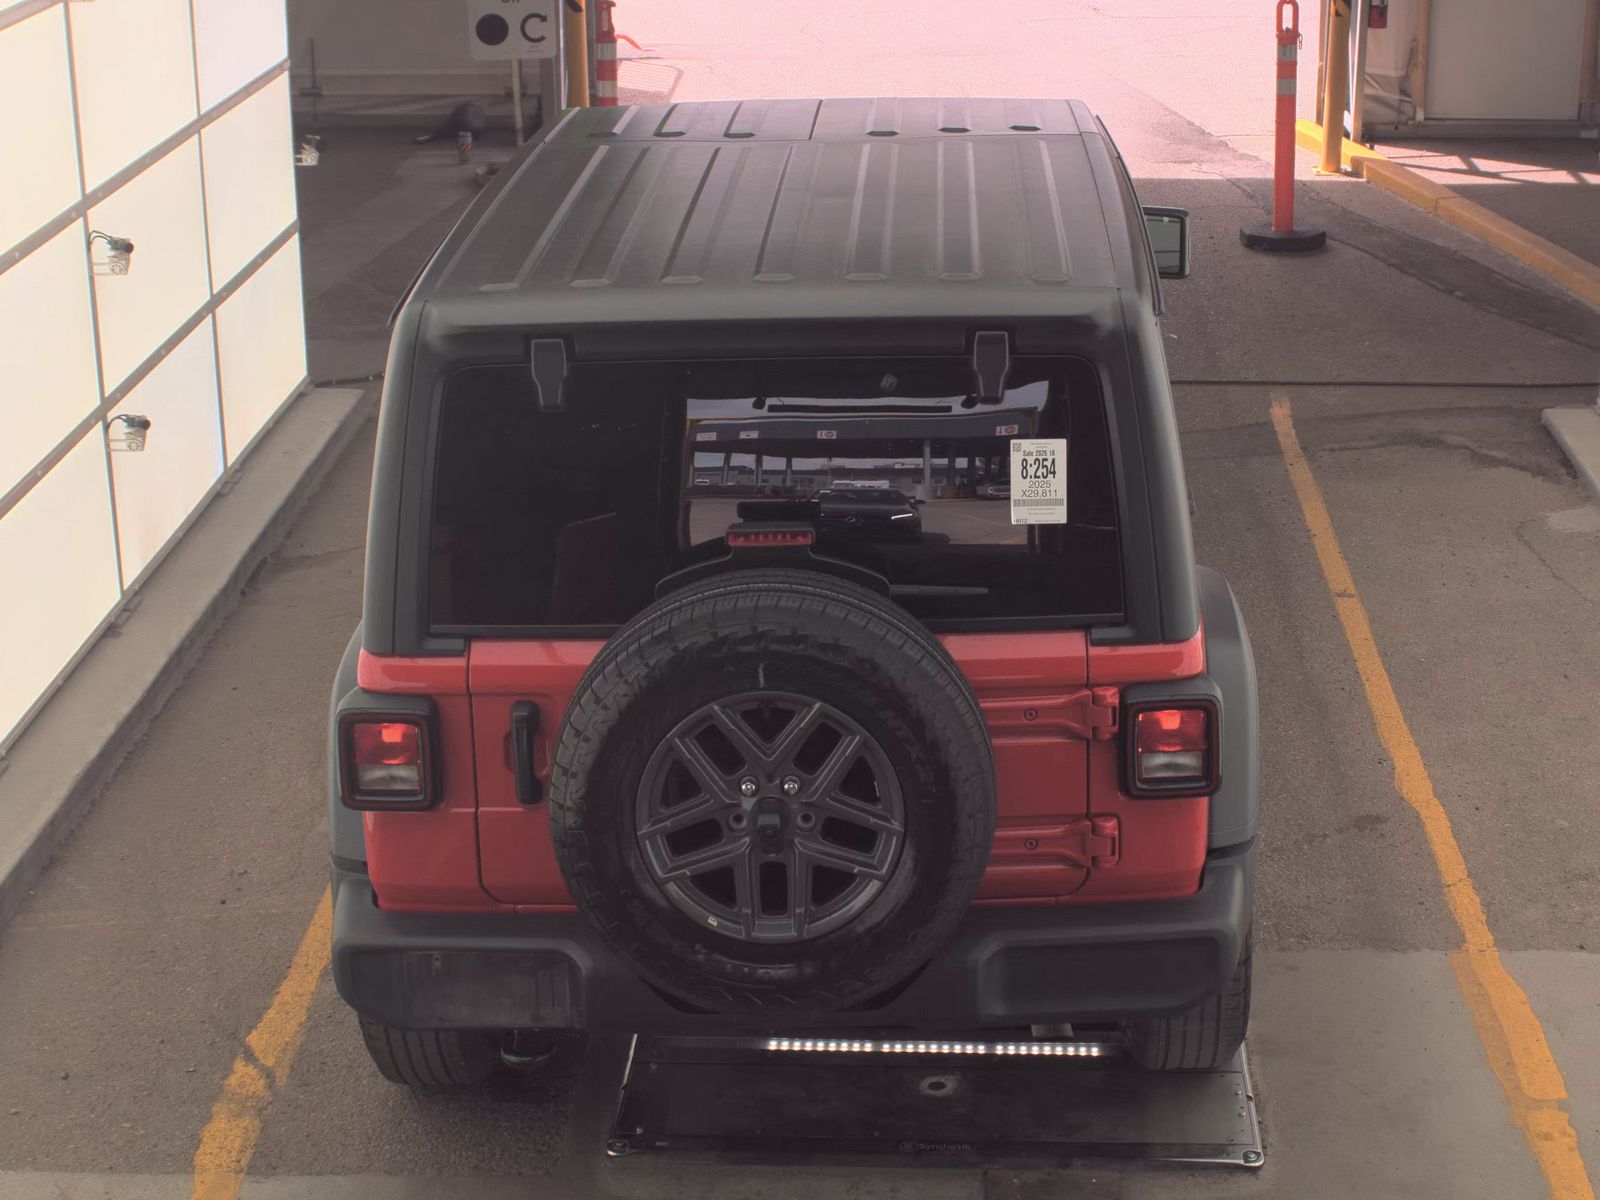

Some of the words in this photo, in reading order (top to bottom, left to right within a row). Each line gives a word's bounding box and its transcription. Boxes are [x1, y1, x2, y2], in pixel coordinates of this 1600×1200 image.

[1021, 458, 1056, 479] 8:254
[1028, 480, 1051, 488] 2025
[1021, 489, 1057, 498] X29,811
